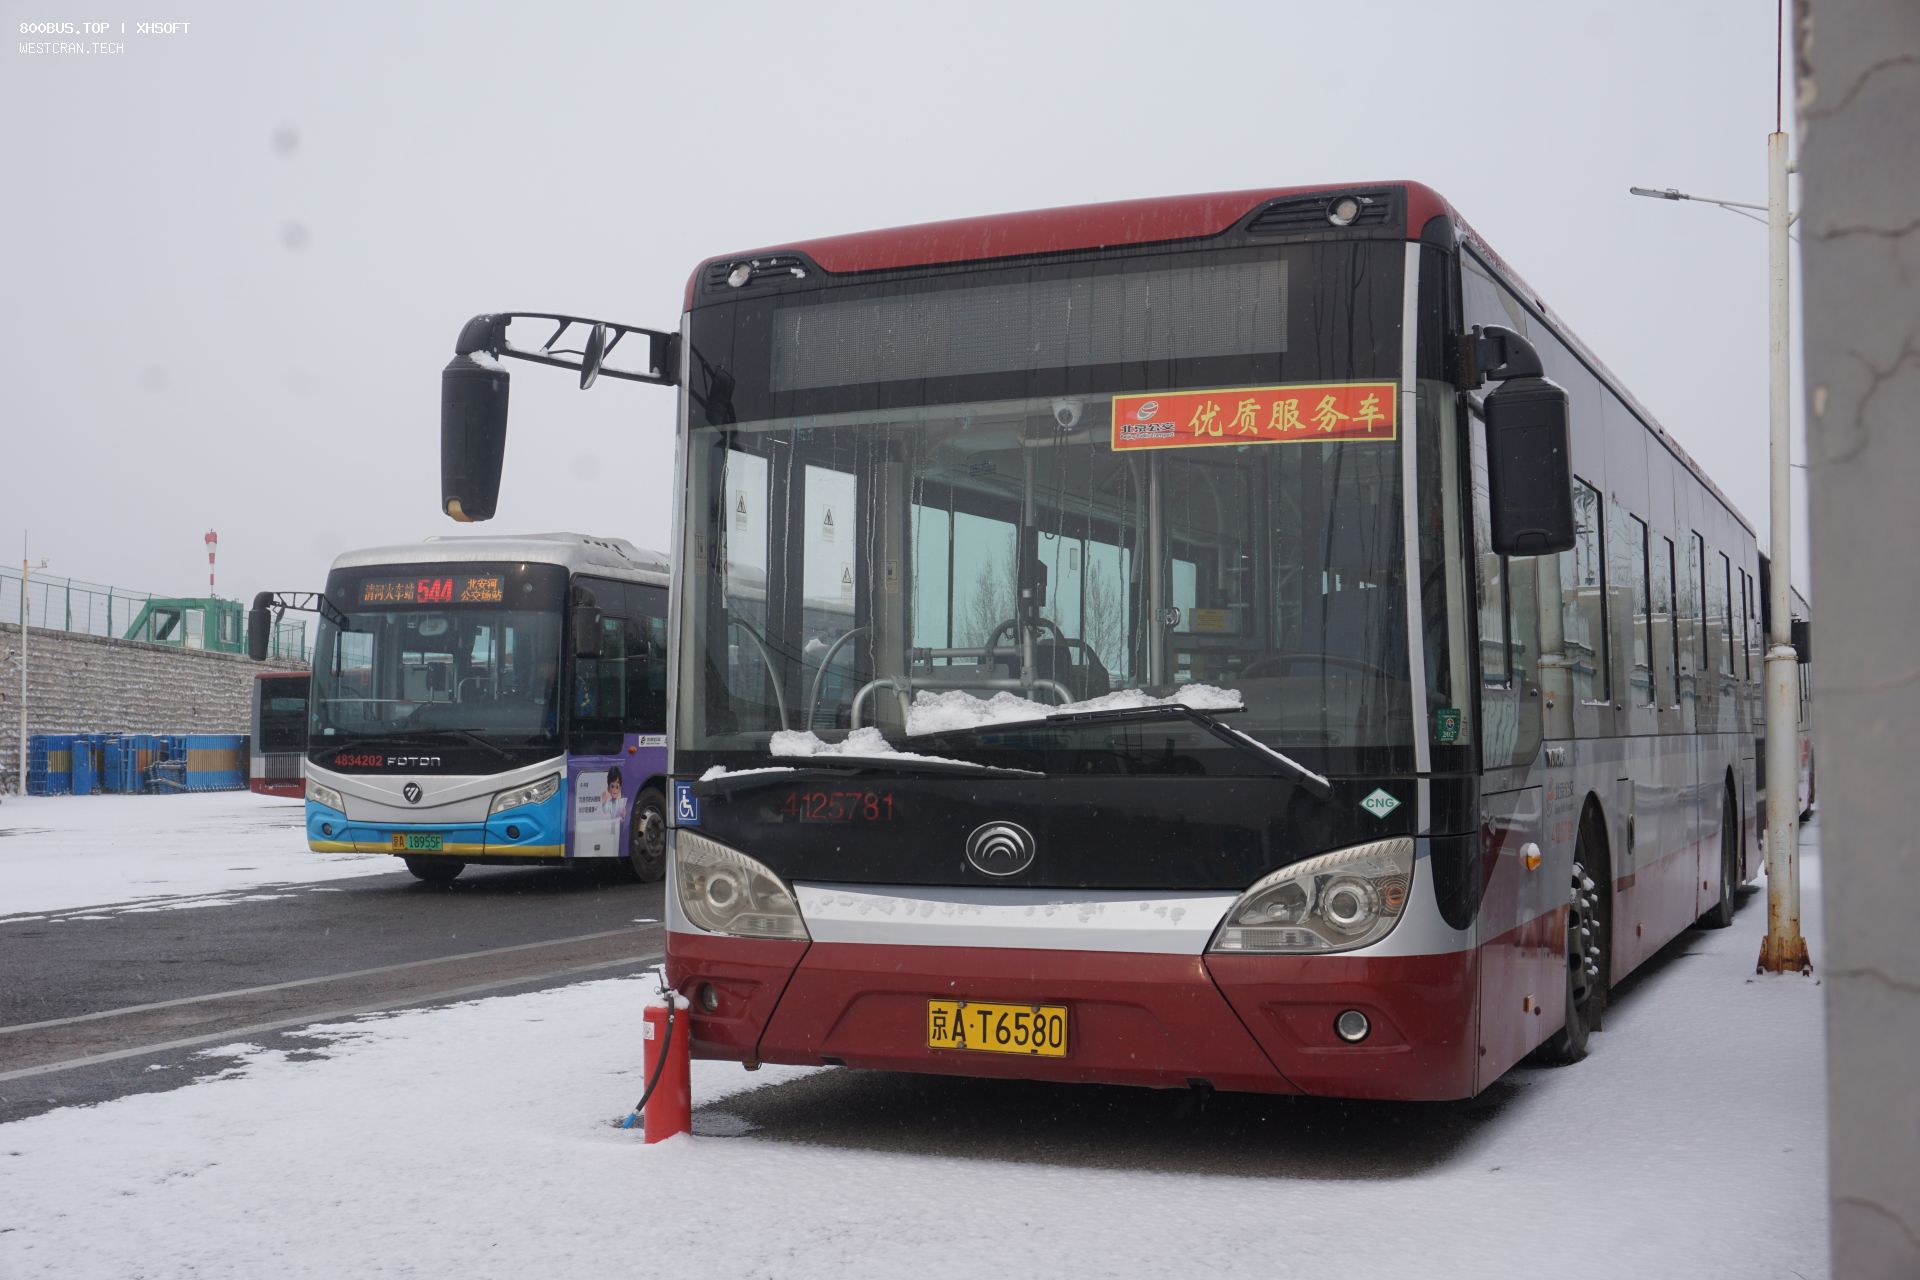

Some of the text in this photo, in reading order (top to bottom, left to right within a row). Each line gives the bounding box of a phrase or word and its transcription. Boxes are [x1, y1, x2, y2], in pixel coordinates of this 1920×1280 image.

[1188, 393, 1385, 437] 优质服务车
[1120, 422, 1175, 433] 北京公交
[416, 578, 454, 603] 544
[335, 754, 384, 767] 4834202
[387, 756, 441, 767] FOTON
[780, 791, 894, 821] 4125781
[1366, 798, 1395, 809] CNG
